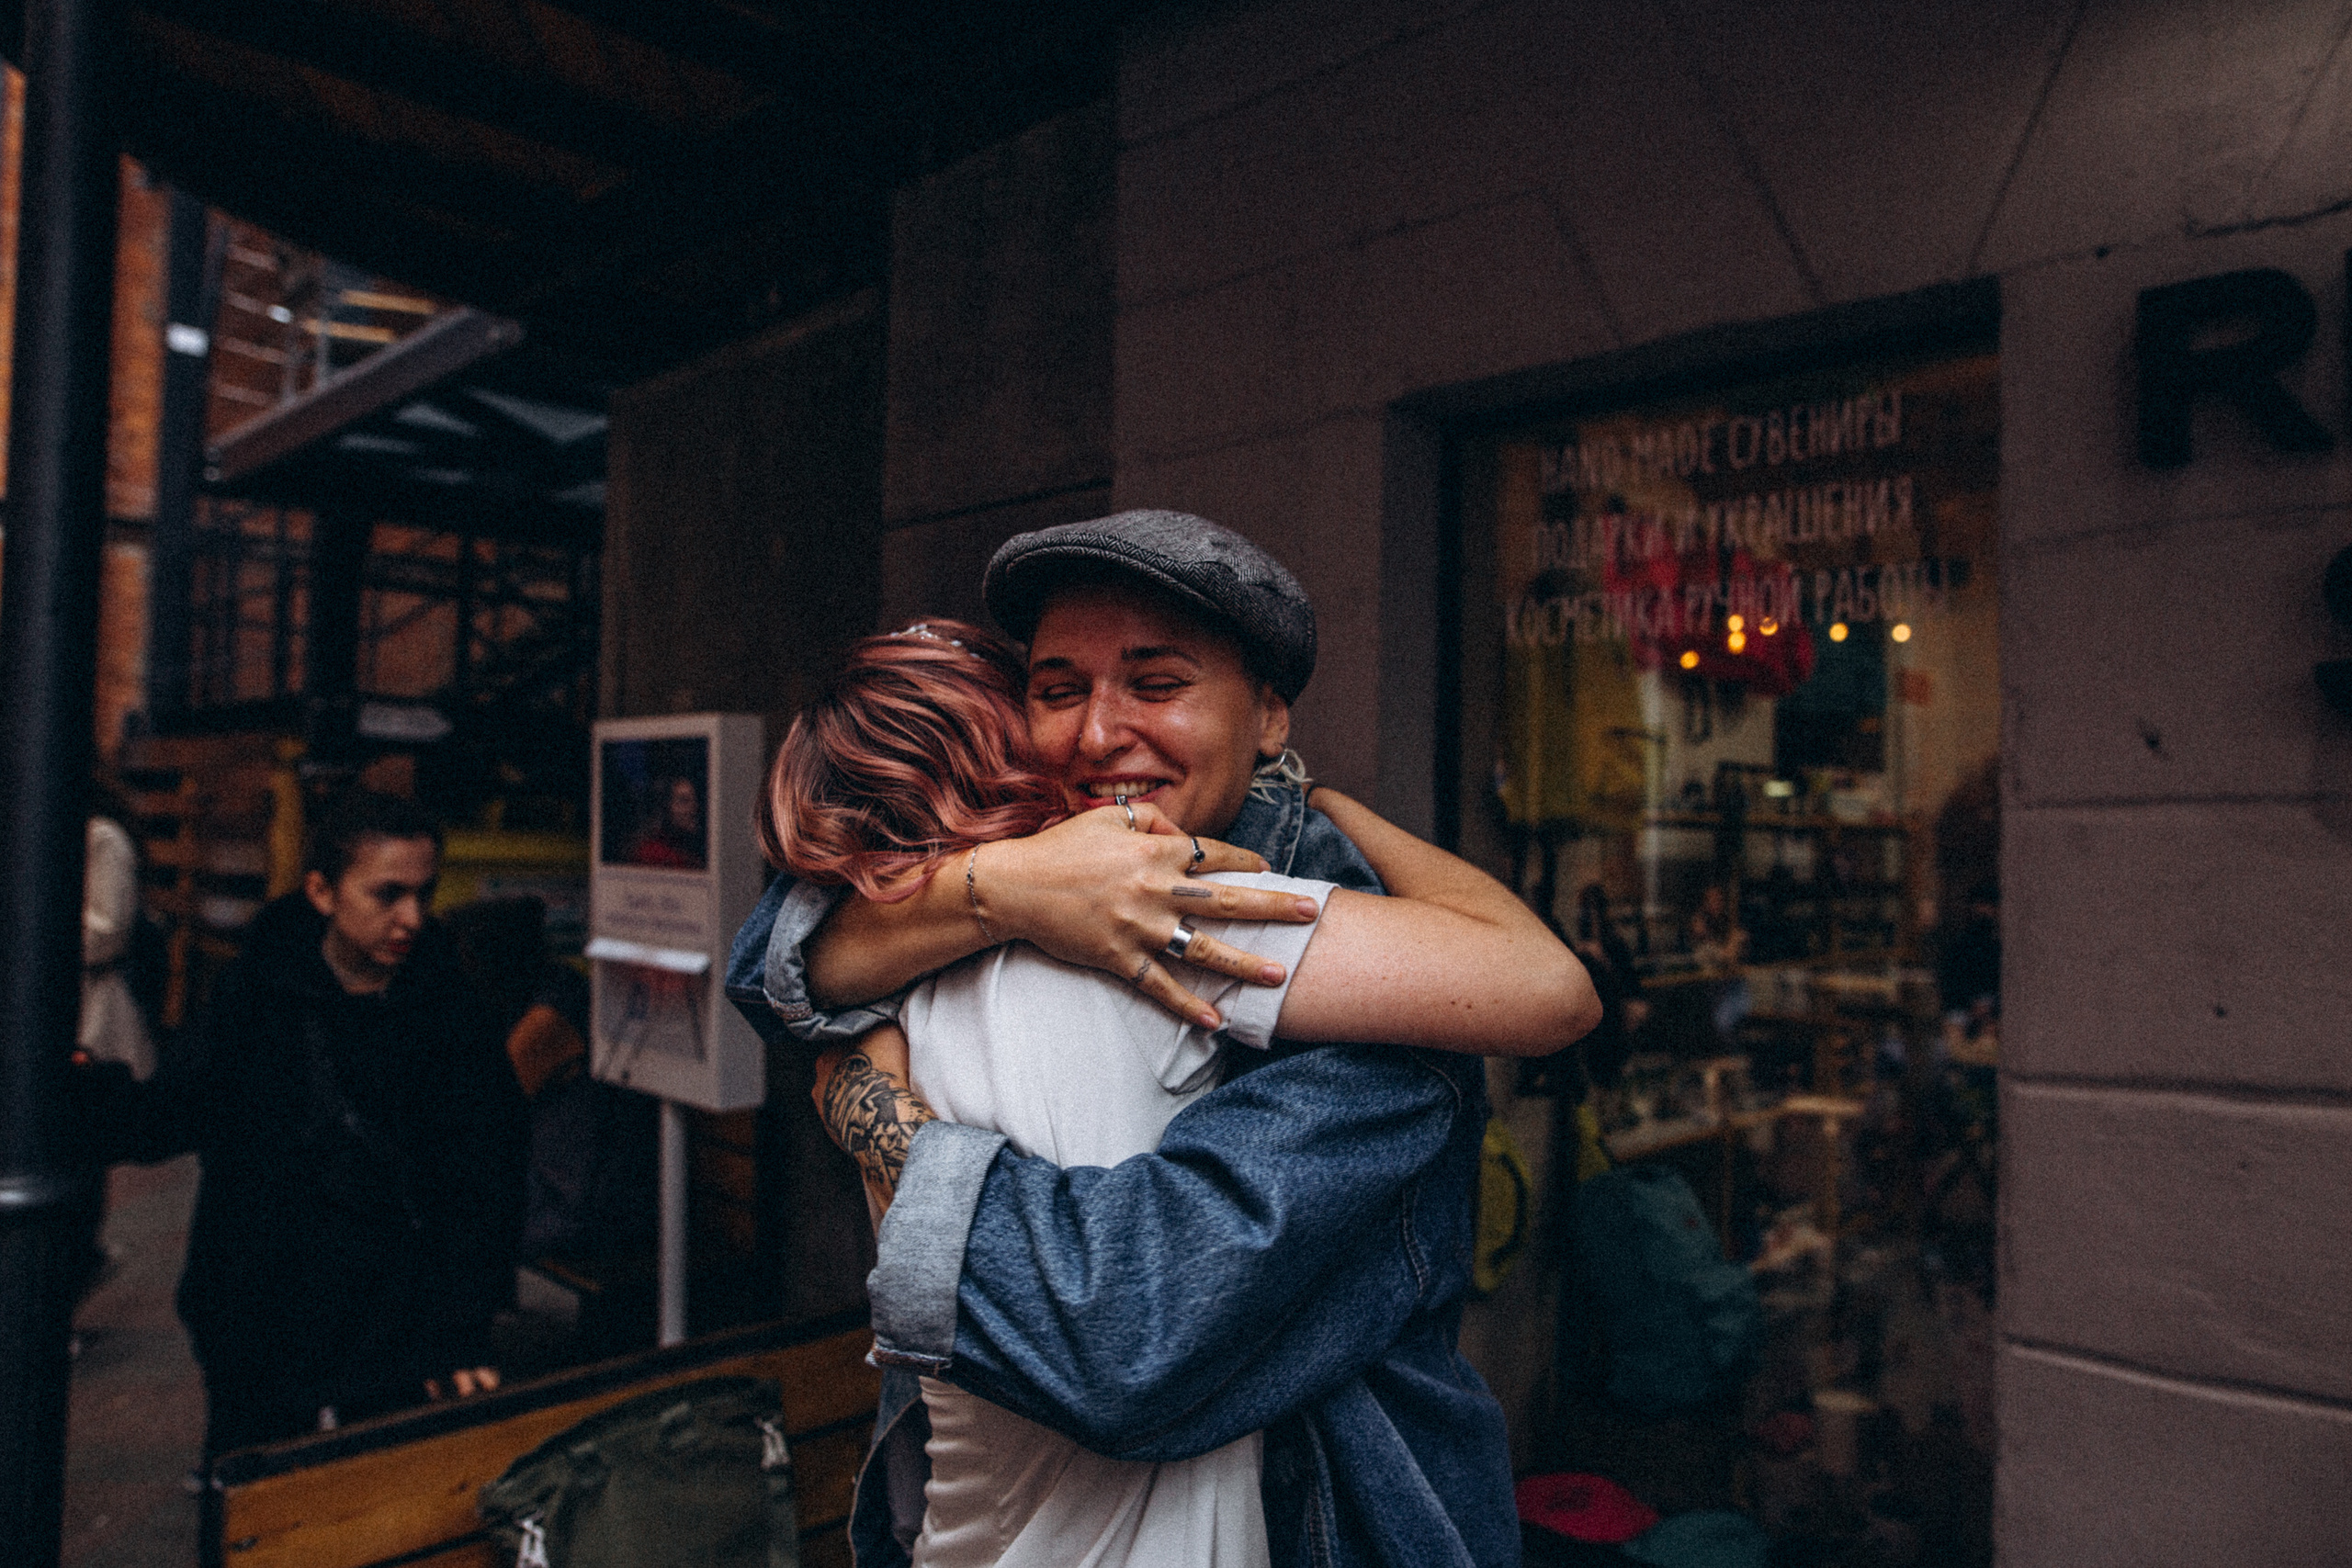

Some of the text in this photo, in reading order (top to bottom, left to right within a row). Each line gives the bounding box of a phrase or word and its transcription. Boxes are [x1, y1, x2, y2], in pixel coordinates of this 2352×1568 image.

[2138, 250, 2352, 469] R
[1727, 388, 1904, 470] СУВЕНИРЫ
[1705, 474, 1915, 551] УКРАШЕНИЯ
[1505, 583, 1676, 649] КОСМЕТИКА
[1684, 563, 1803, 634] РУЧНОЙ
